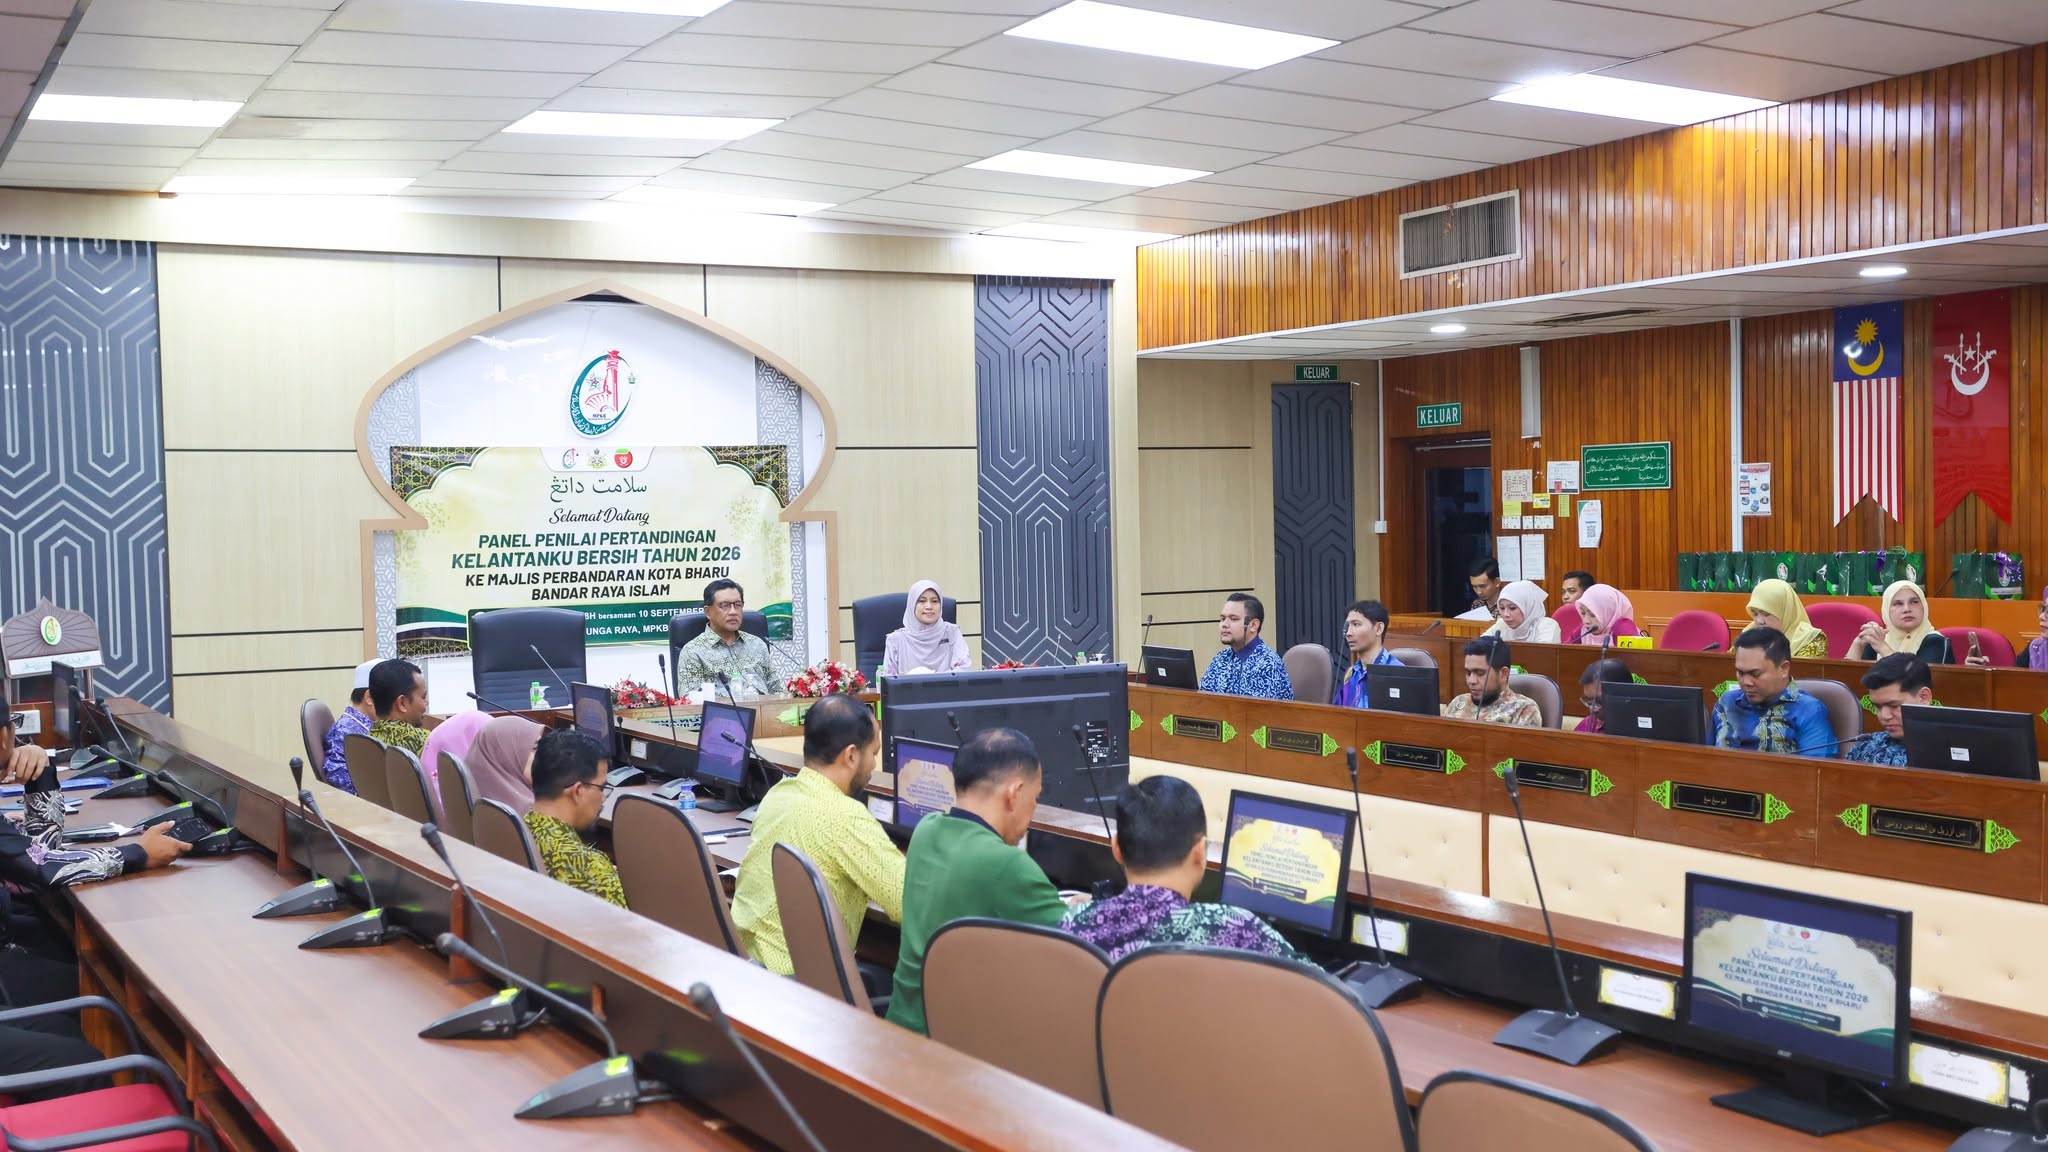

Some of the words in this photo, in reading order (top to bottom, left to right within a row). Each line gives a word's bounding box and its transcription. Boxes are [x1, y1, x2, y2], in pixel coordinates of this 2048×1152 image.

[1303, 367, 1330, 379] KELUAR
[1420, 407, 1458, 425] KELUAR
[593, 476, 647, 493] سلامت
[549, 508, 602, 524] Selamat
[603, 507, 650, 526] Datang
[479, 534, 531, 548] PANEL
[535, 532, 596, 547] PENILAI
[600, 530, 716, 545] PERTANDINGAN
[452, 551, 573, 569] KELANTANKU
[577, 549, 638, 566] BERSIH
[642, 548, 698, 564] TAHUN
[701, 546, 741, 561] 2026
[465, 574, 484, 586] KE
[488, 572, 540, 586] MAJLIS
[543, 569, 645, 584] PERBANDARAN
[648, 568, 682, 581] KOTA
[685, 566, 729, 579] BHARU
[532, 587, 588, 600] BANDAR
[591, 585, 626, 598] RAYA
[629, 584, 670, 597] ISLAM
[586, 627, 612, 636] UNGA
[614, 626, 641, 635] RAYA,
